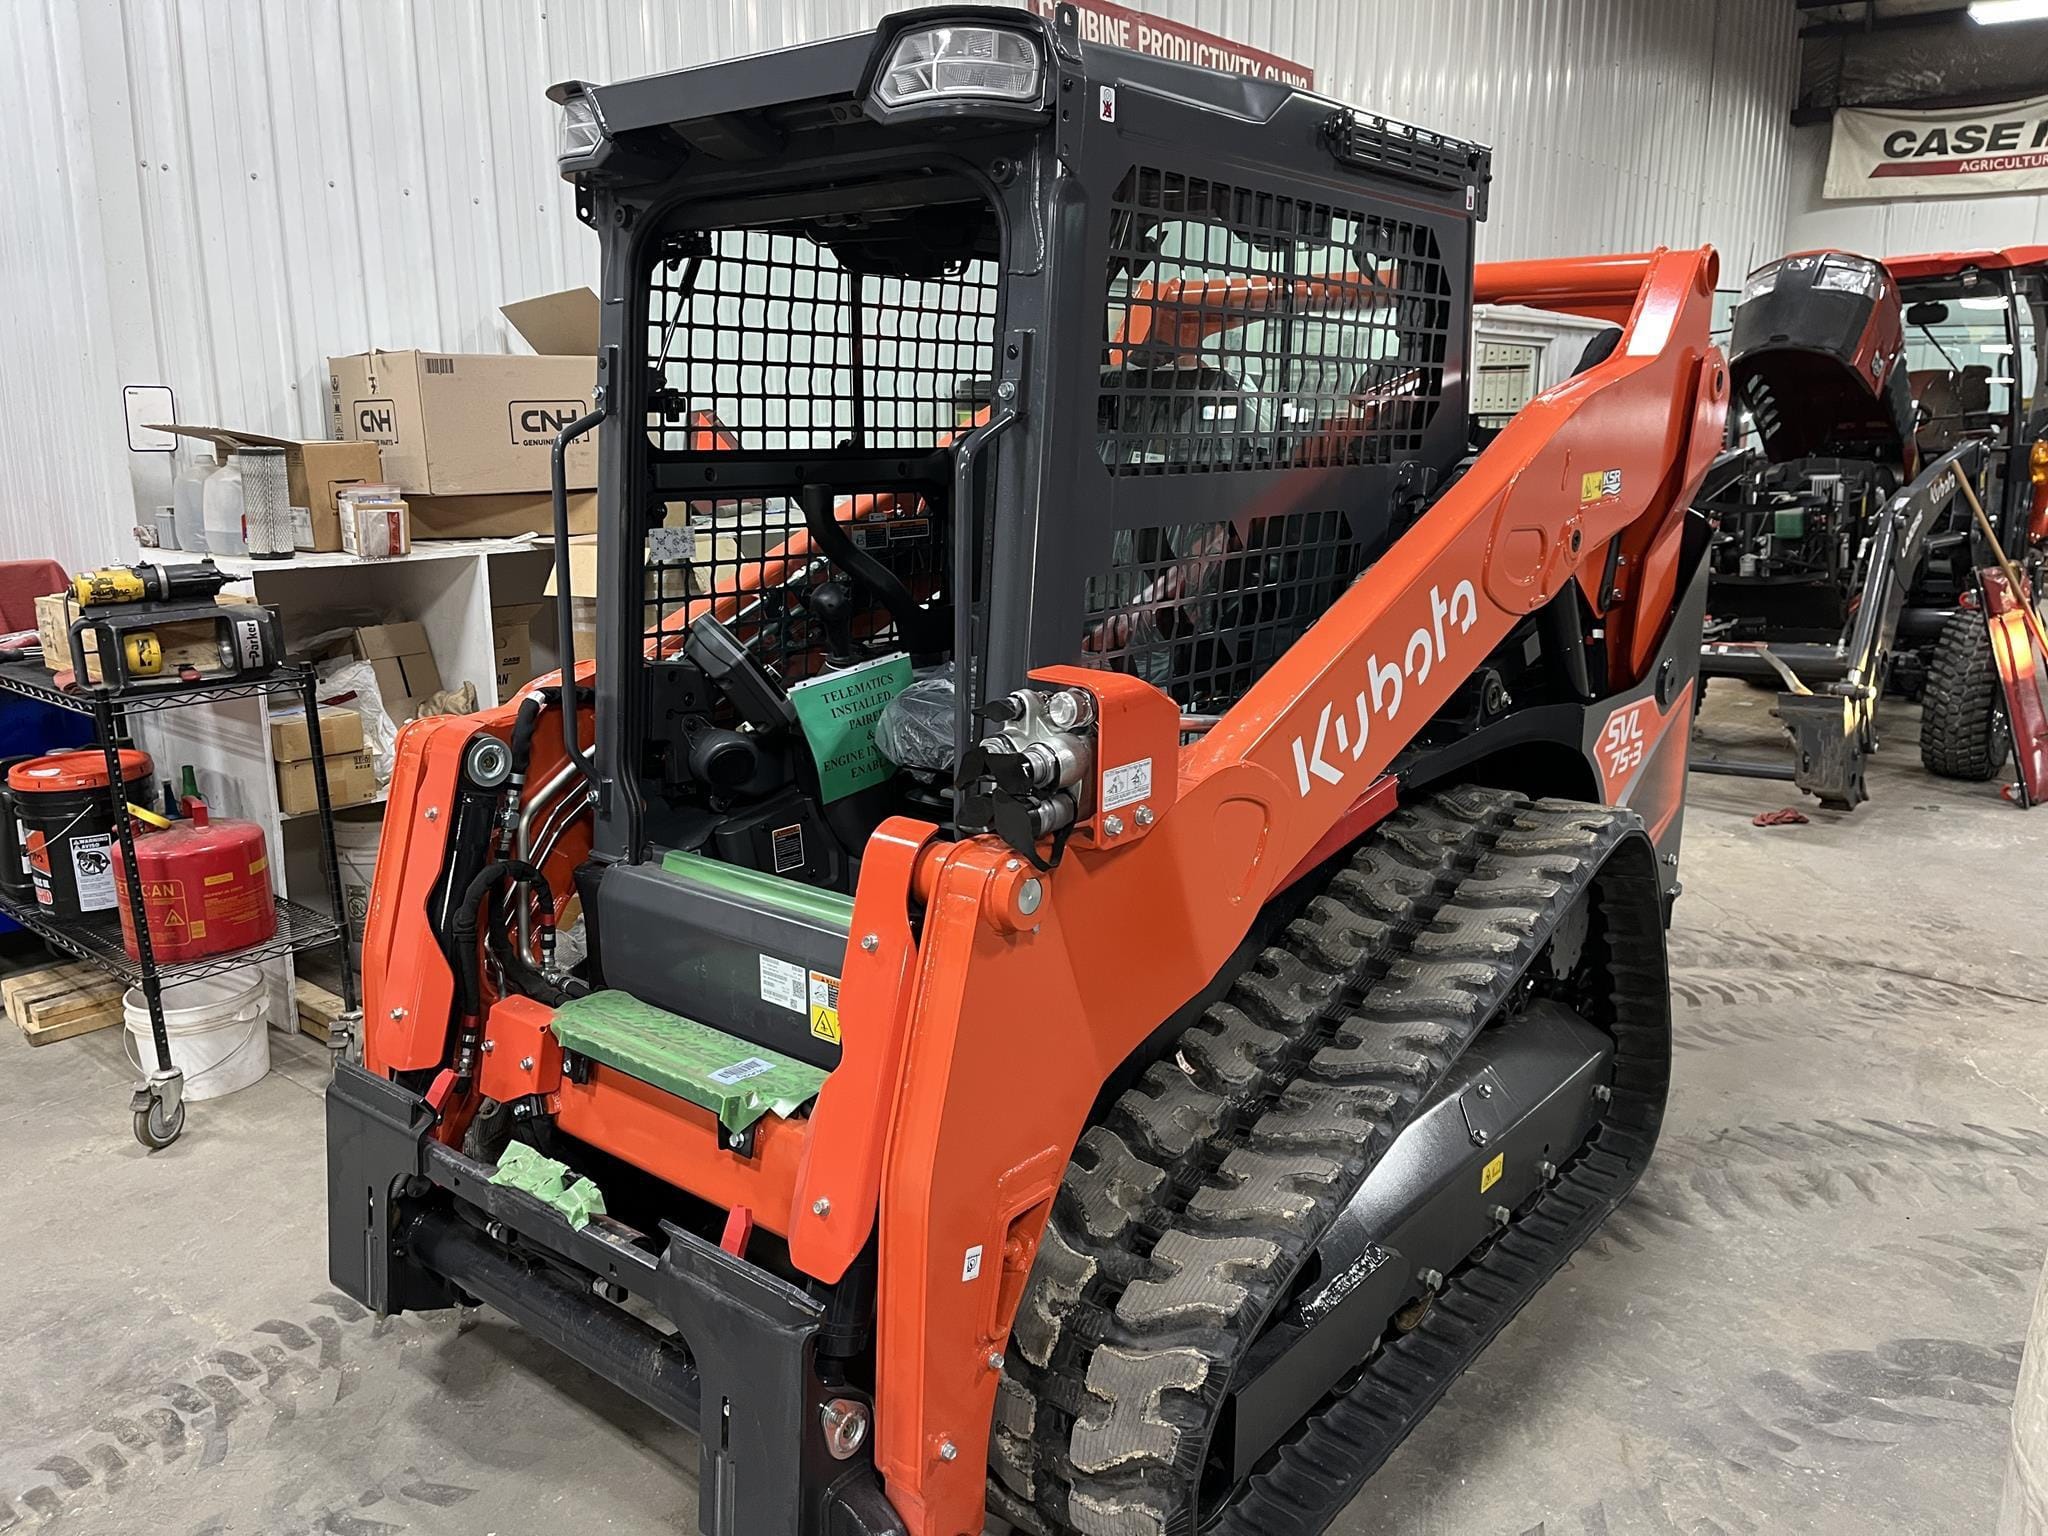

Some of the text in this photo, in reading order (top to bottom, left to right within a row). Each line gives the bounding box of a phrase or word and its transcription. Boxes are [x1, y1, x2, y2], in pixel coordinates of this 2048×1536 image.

[1138, 24, 1261, 78] PRODUCTIVITY
[1883, 121, 2026, 159] CASE
[360, 409, 392, 432] CNH
[521, 409, 578, 433] CNH
[246, 622, 260, 668] Parker
[821, 672, 895, 705] TELEMATICS
[830, 689, 895, 719] INSTALLED.
[1291, 579, 1478, 798] Kubota
[848, 708, 884, 730] PAIRE
[1604, 708, 1644, 753] SVL
[823, 749, 865, 773] ENGINE
[1609, 740, 1644, 778] 75-3
[141, 883, 175, 897] CAN
